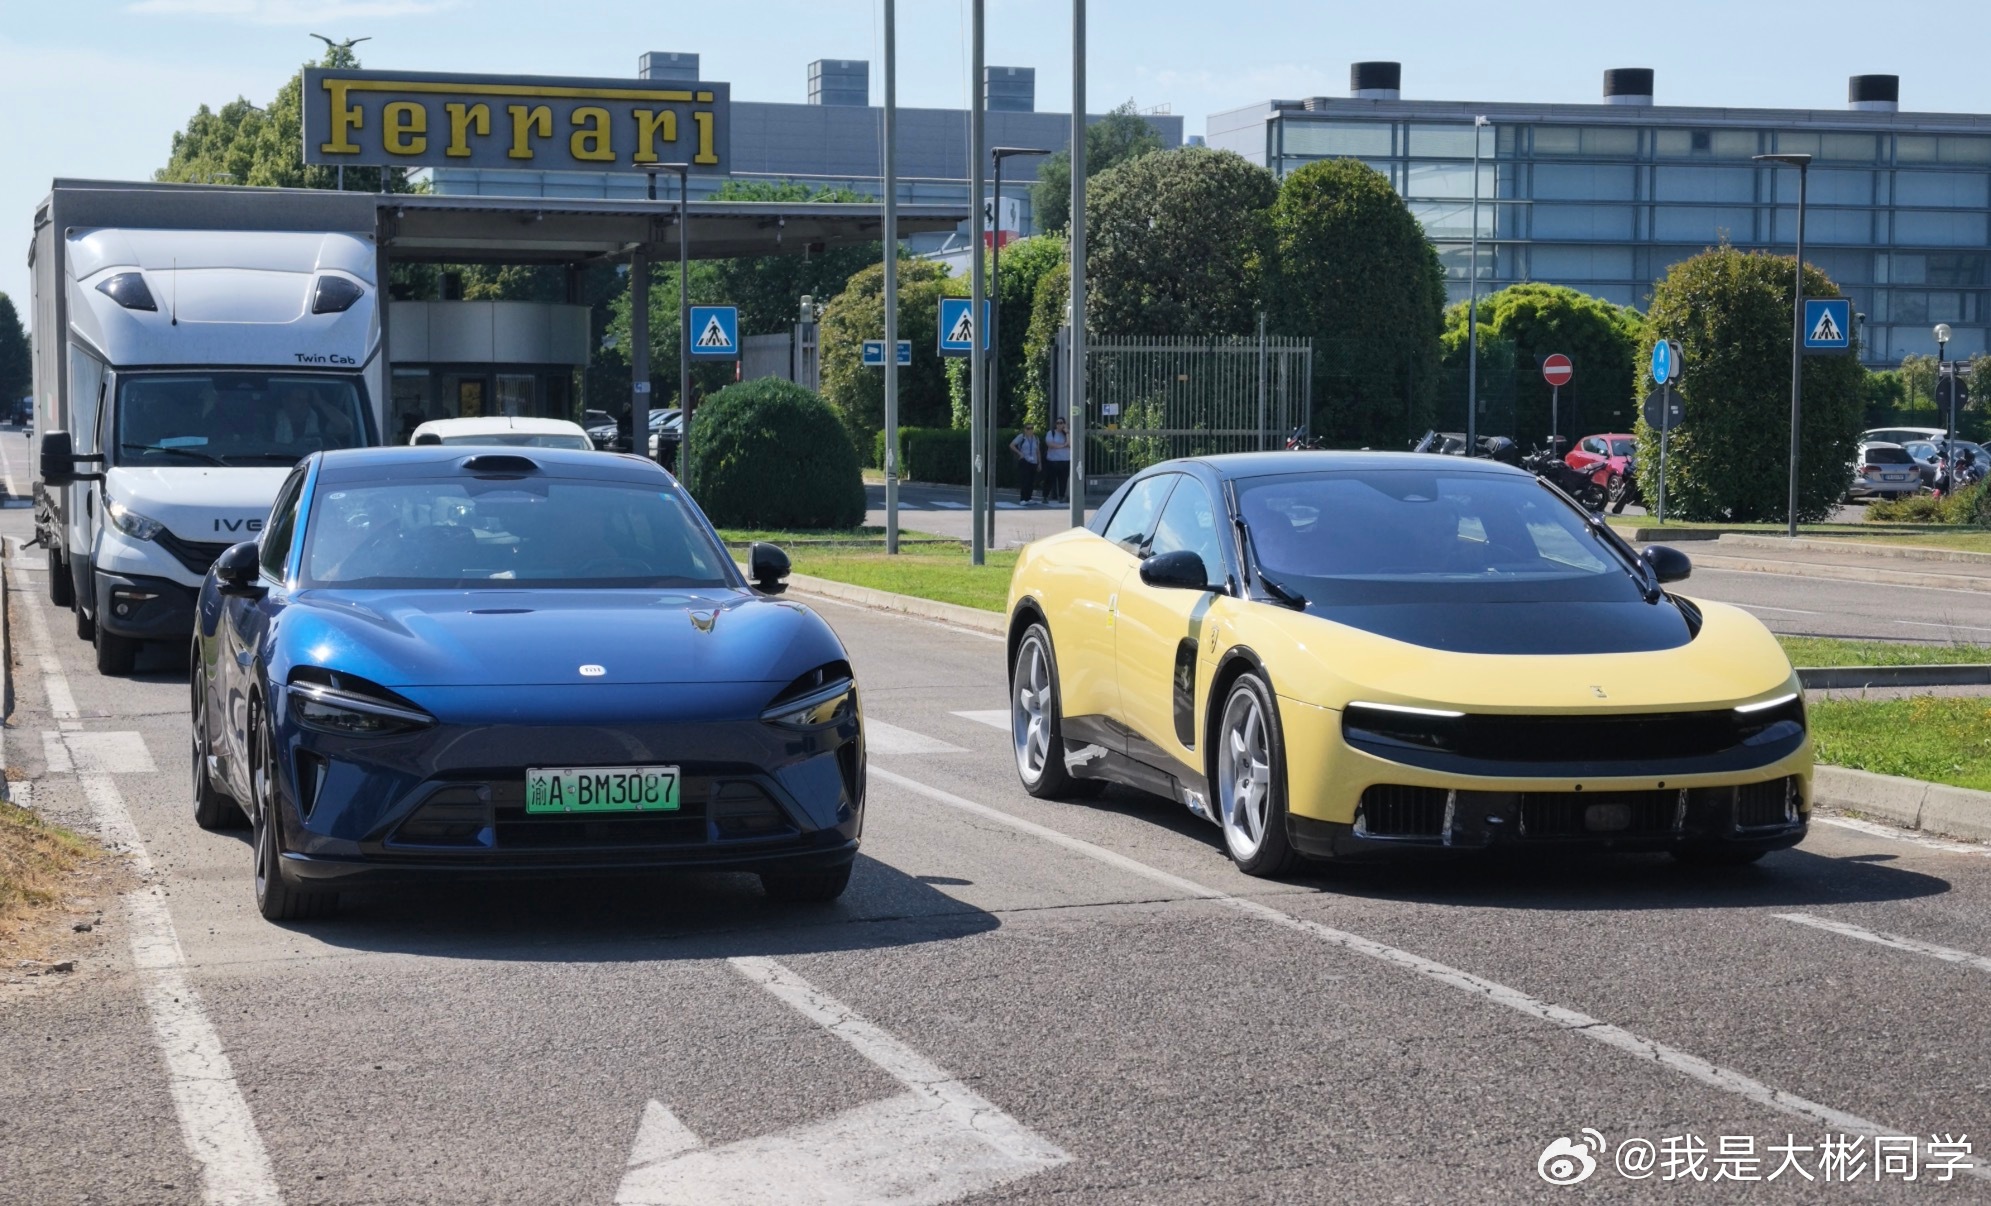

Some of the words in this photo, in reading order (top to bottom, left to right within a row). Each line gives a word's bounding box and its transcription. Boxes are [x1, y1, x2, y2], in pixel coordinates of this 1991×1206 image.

[321, 78, 719, 164] Ferrari
[294, 353, 326, 363] Twin
[329, 354, 356, 365] Cab
[214, 518, 263, 532] IVE
[578, 773, 676, 805] BM3087
